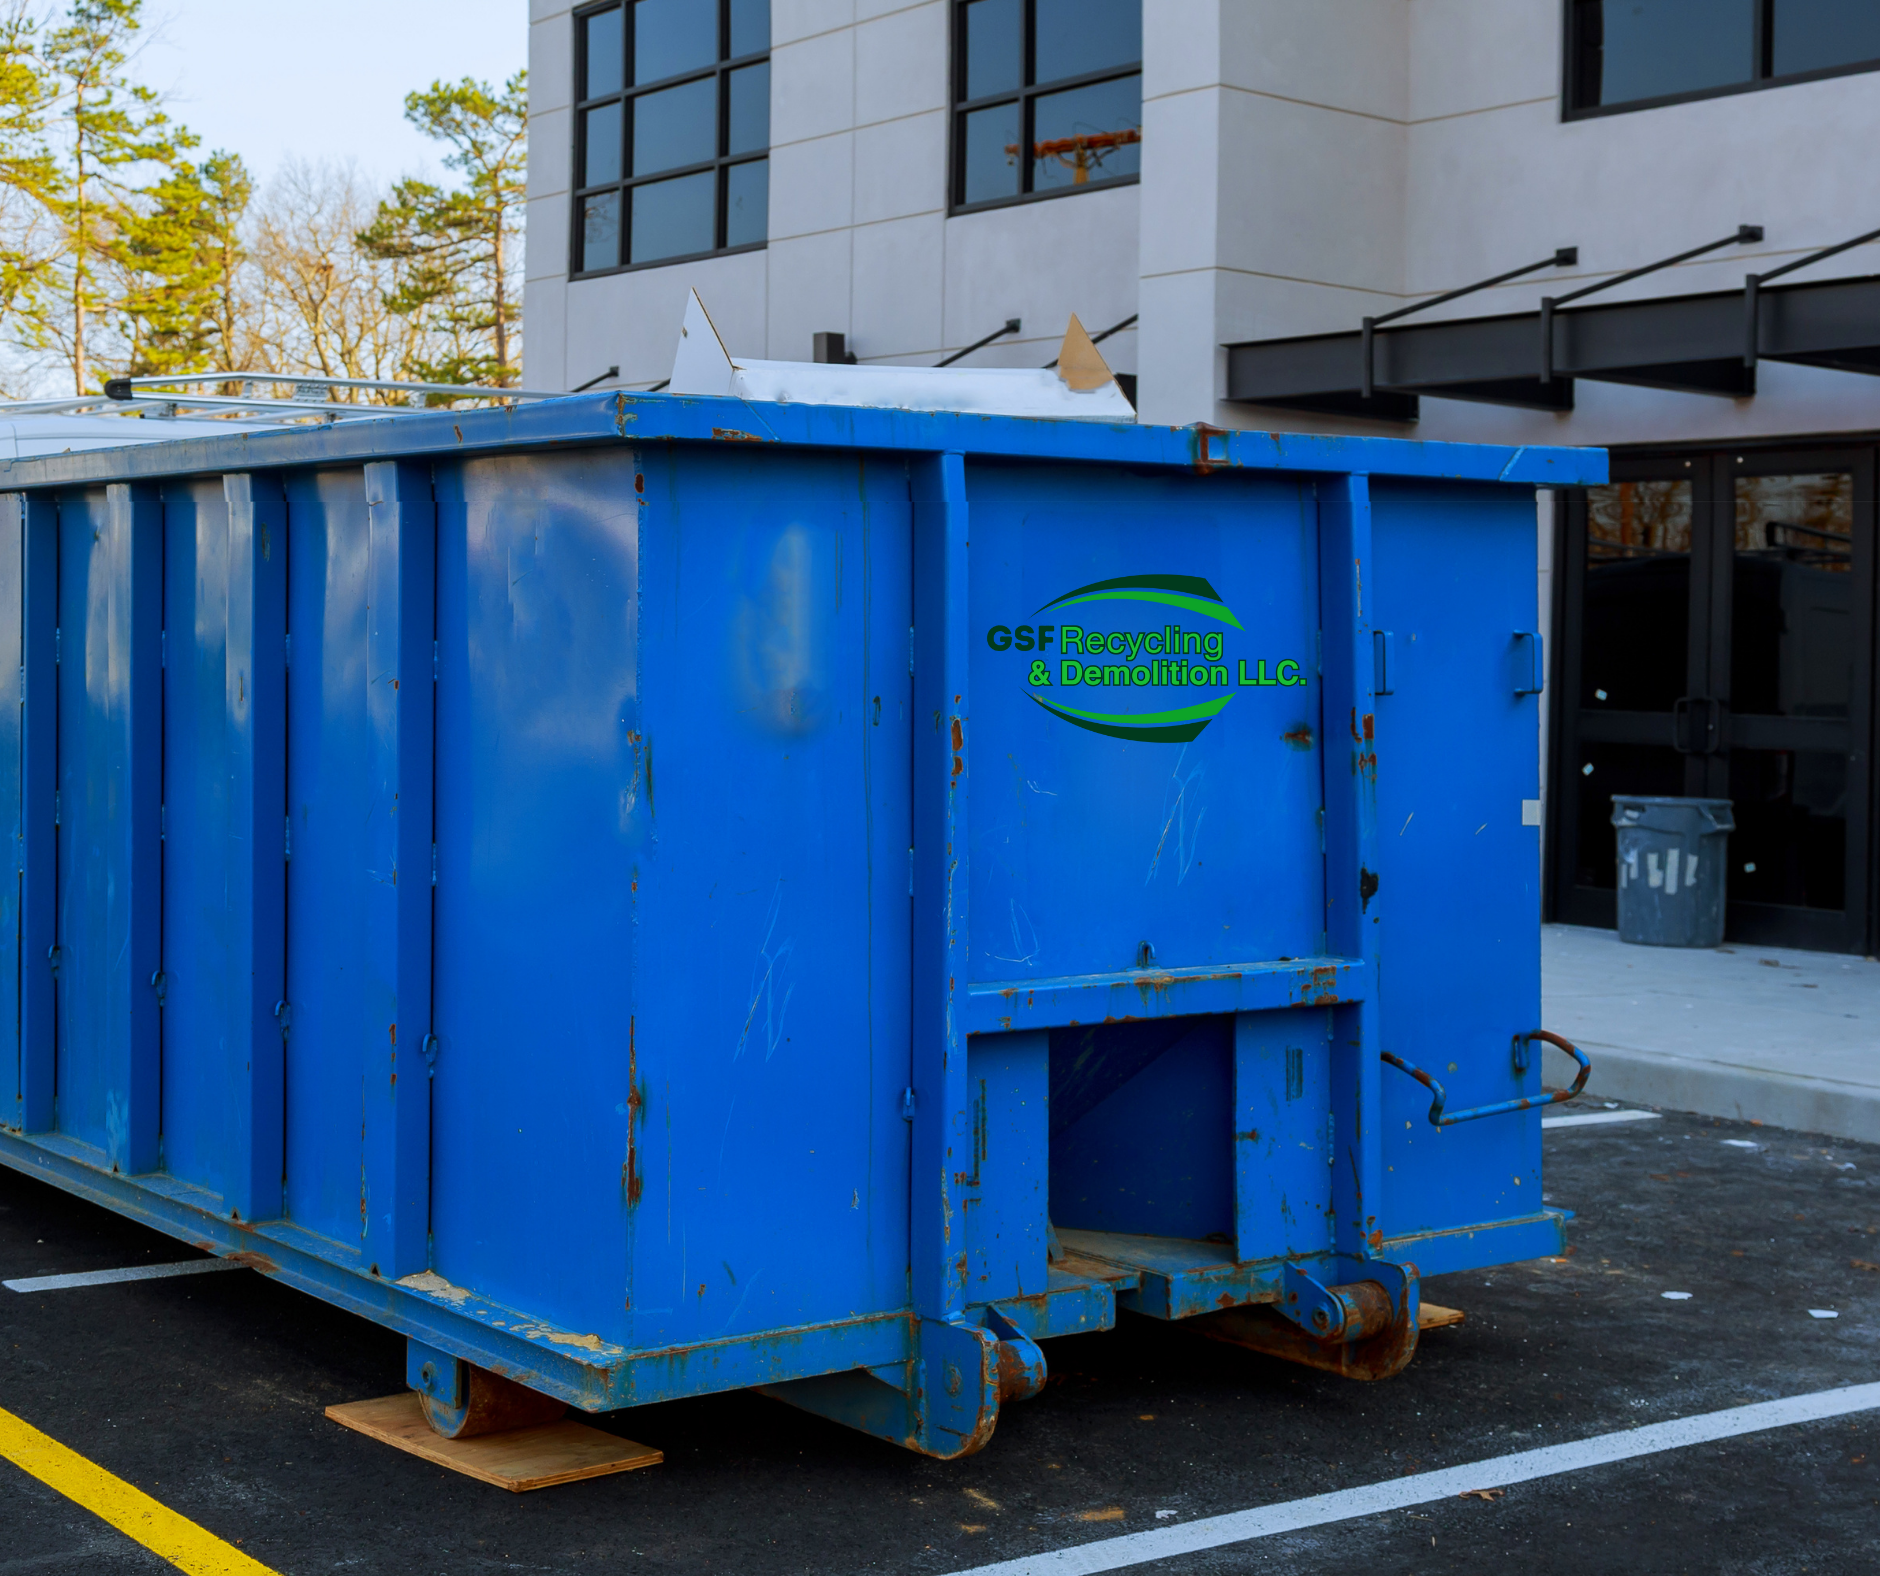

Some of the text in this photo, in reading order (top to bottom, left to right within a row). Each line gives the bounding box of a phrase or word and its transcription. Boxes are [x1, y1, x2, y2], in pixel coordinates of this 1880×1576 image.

[987, 625, 1223, 661] GSF Recycling
[1028, 659, 1307, 686] & Demolition LLC.
